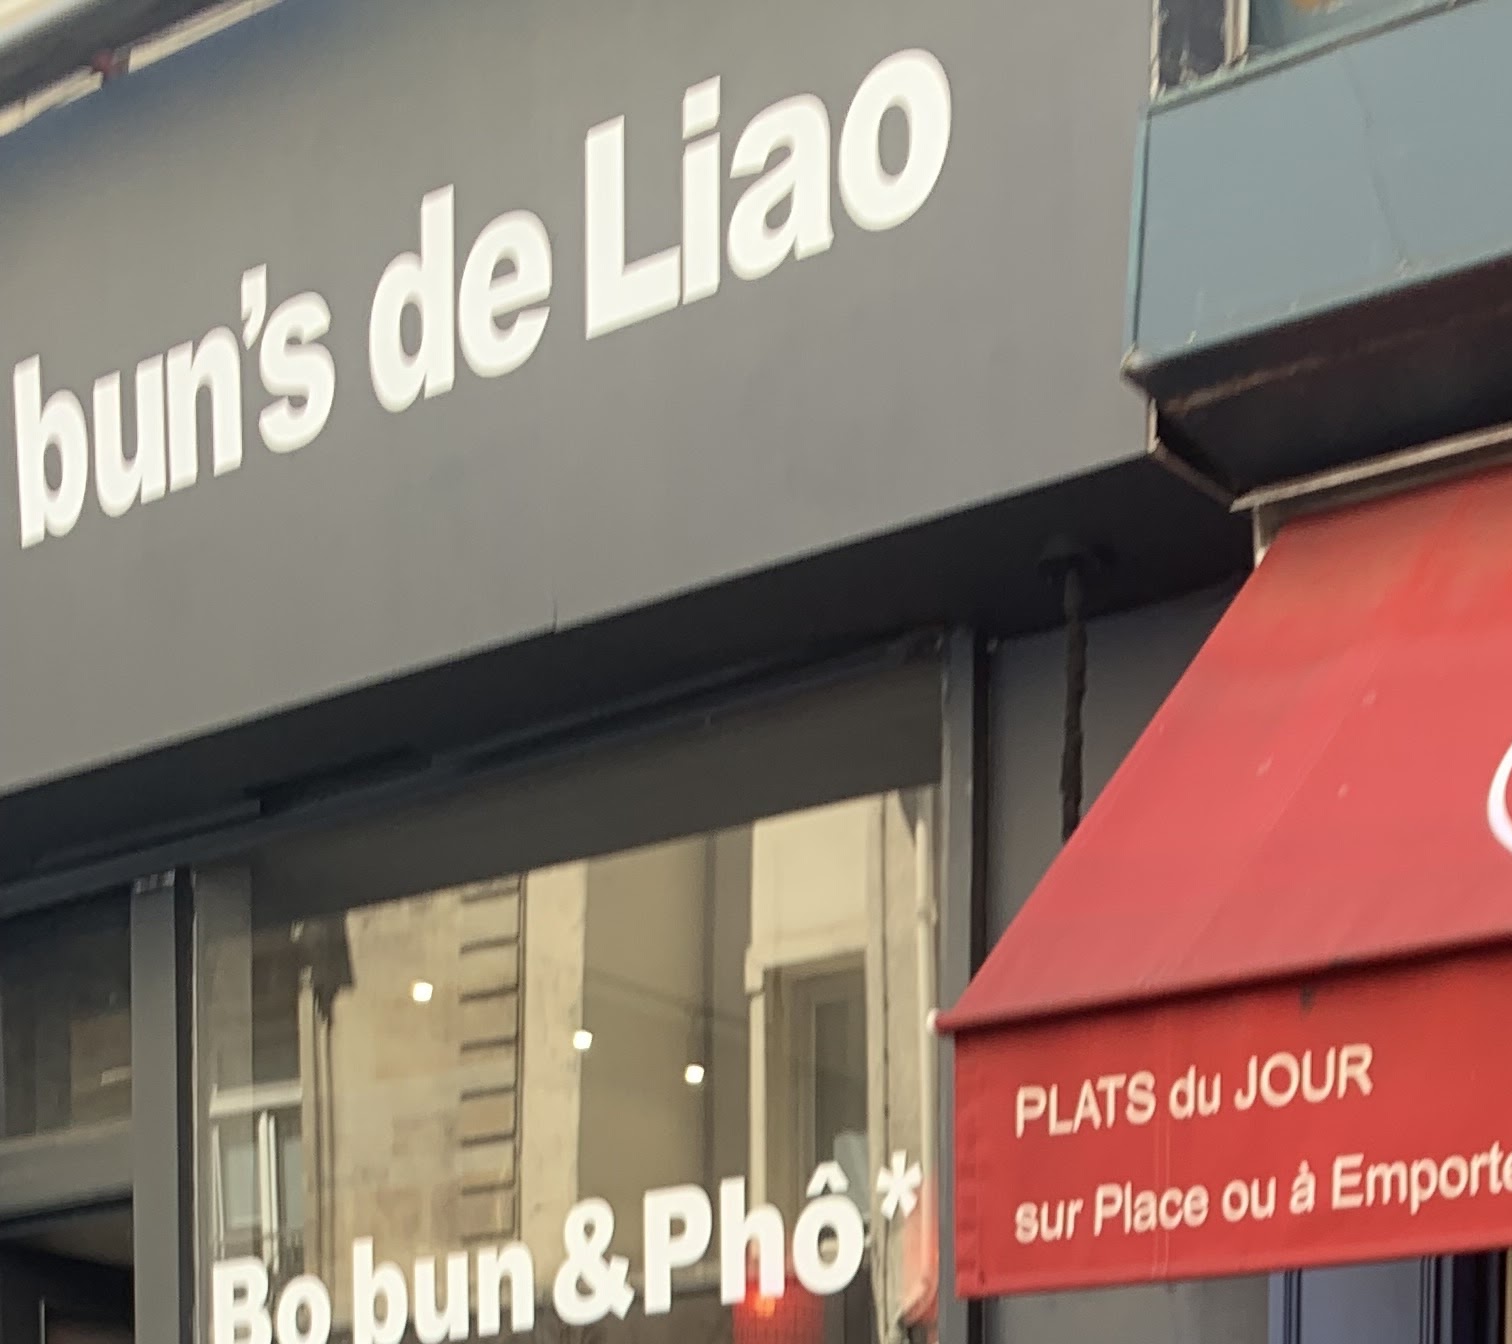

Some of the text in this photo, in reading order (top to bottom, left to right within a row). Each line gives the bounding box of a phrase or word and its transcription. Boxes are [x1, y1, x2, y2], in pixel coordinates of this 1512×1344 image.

[13, 48, 951, 548] bun's de Liao
[1014, 1042, 1374, 1139] PLATS du JOUR
[1014, 1194, 1082, 1244] sur
[1093, 1181, 1209, 1237] Place
[1221, 1174, 1276, 1223] ou
[1289, 1161, 1316, 1215] à
